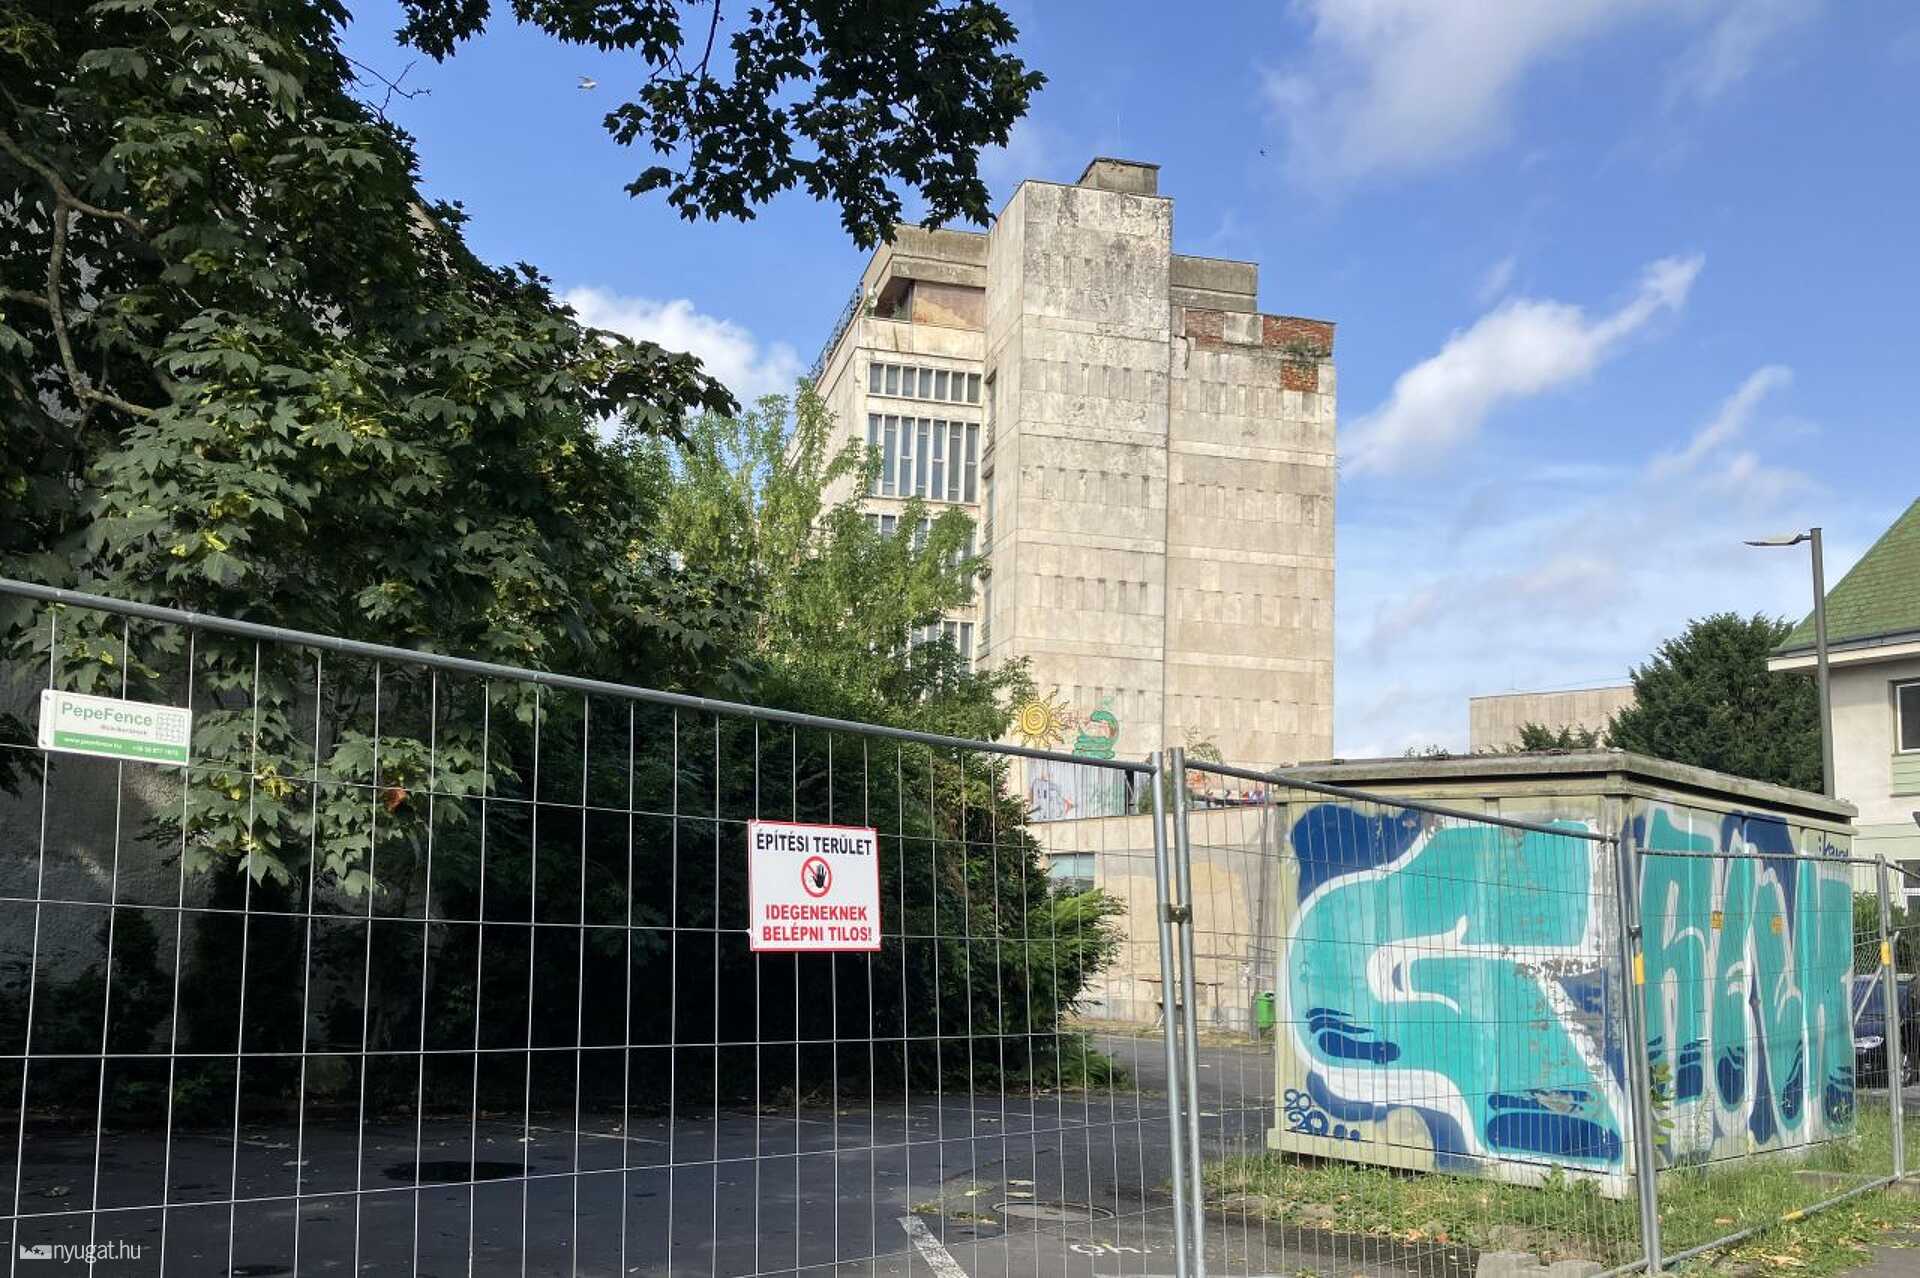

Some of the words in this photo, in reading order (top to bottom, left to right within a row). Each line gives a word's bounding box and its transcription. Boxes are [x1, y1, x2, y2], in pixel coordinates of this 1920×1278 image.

[62, 702, 152, 726] PepeFence
[757, 829, 809, 852] ÉPÍTÉSI
[813, 835, 872, 855] TERÜLET
[766, 905, 867, 921] IDEGENEKNEK
[763, 923, 823, 941] BELÉPNI
[828, 927, 872, 942] TILOS!
